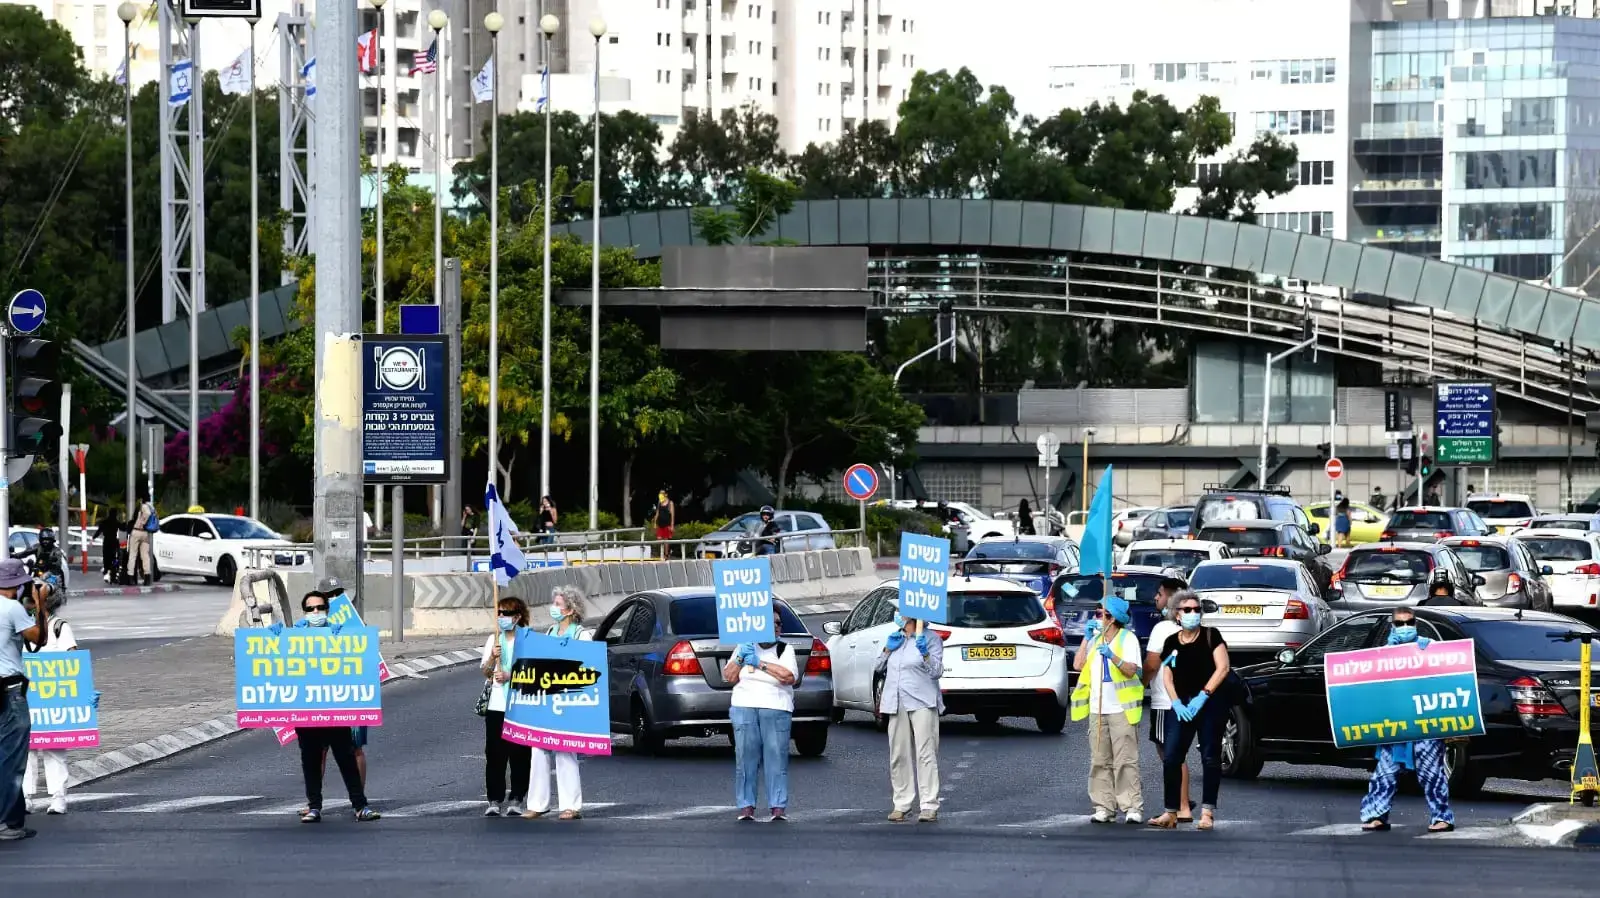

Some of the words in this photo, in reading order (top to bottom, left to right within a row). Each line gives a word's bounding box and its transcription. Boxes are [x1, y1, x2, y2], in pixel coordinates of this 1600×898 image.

[365, 413, 389, 422] נקודות
[411, 413, 434, 421] צוברים
[365, 423, 386, 431] טובות
[388, 423, 400, 431] הכי
[401, 423, 435, 431] במסעדות
[908, 543, 941, 564] נשים
[723, 568, 760, 586] נשים
[902, 565, 944, 587] עושות
[719, 590, 769, 609] עושות
[905, 588, 940, 611] שלום
[726, 611, 766, 632] שלום
[246, 636, 280, 655] את
[288, 635, 368, 655] עוצרות
[25, 659, 80, 678] עוצרו
[252, 657, 362, 677] הסיפוח
[1333, 659, 1373, 676] שלום
[1377, 654, 1424, 673] עושות
[1428, 652, 1467, 667] נשים
[29, 680, 77, 699] הסי
[242, 682, 298, 704] שלום
[305, 684, 375, 703] עושות
[508, 688, 547, 712] السلام
[552, 687, 599, 715] نصنع
[1412, 687, 1471, 715] למען
[29, 706, 91, 725] עושות
[240, 715, 263, 724] السلام
[311, 714, 331, 722] שלום
[1414, 715, 1475, 734] עתיד
[1341, 719, 1407, 741] ילדינו
[543, 736, 560, 745] שלום
[563, 739, 585, 748] עושות
[588, 741, 607, 750] נשים
